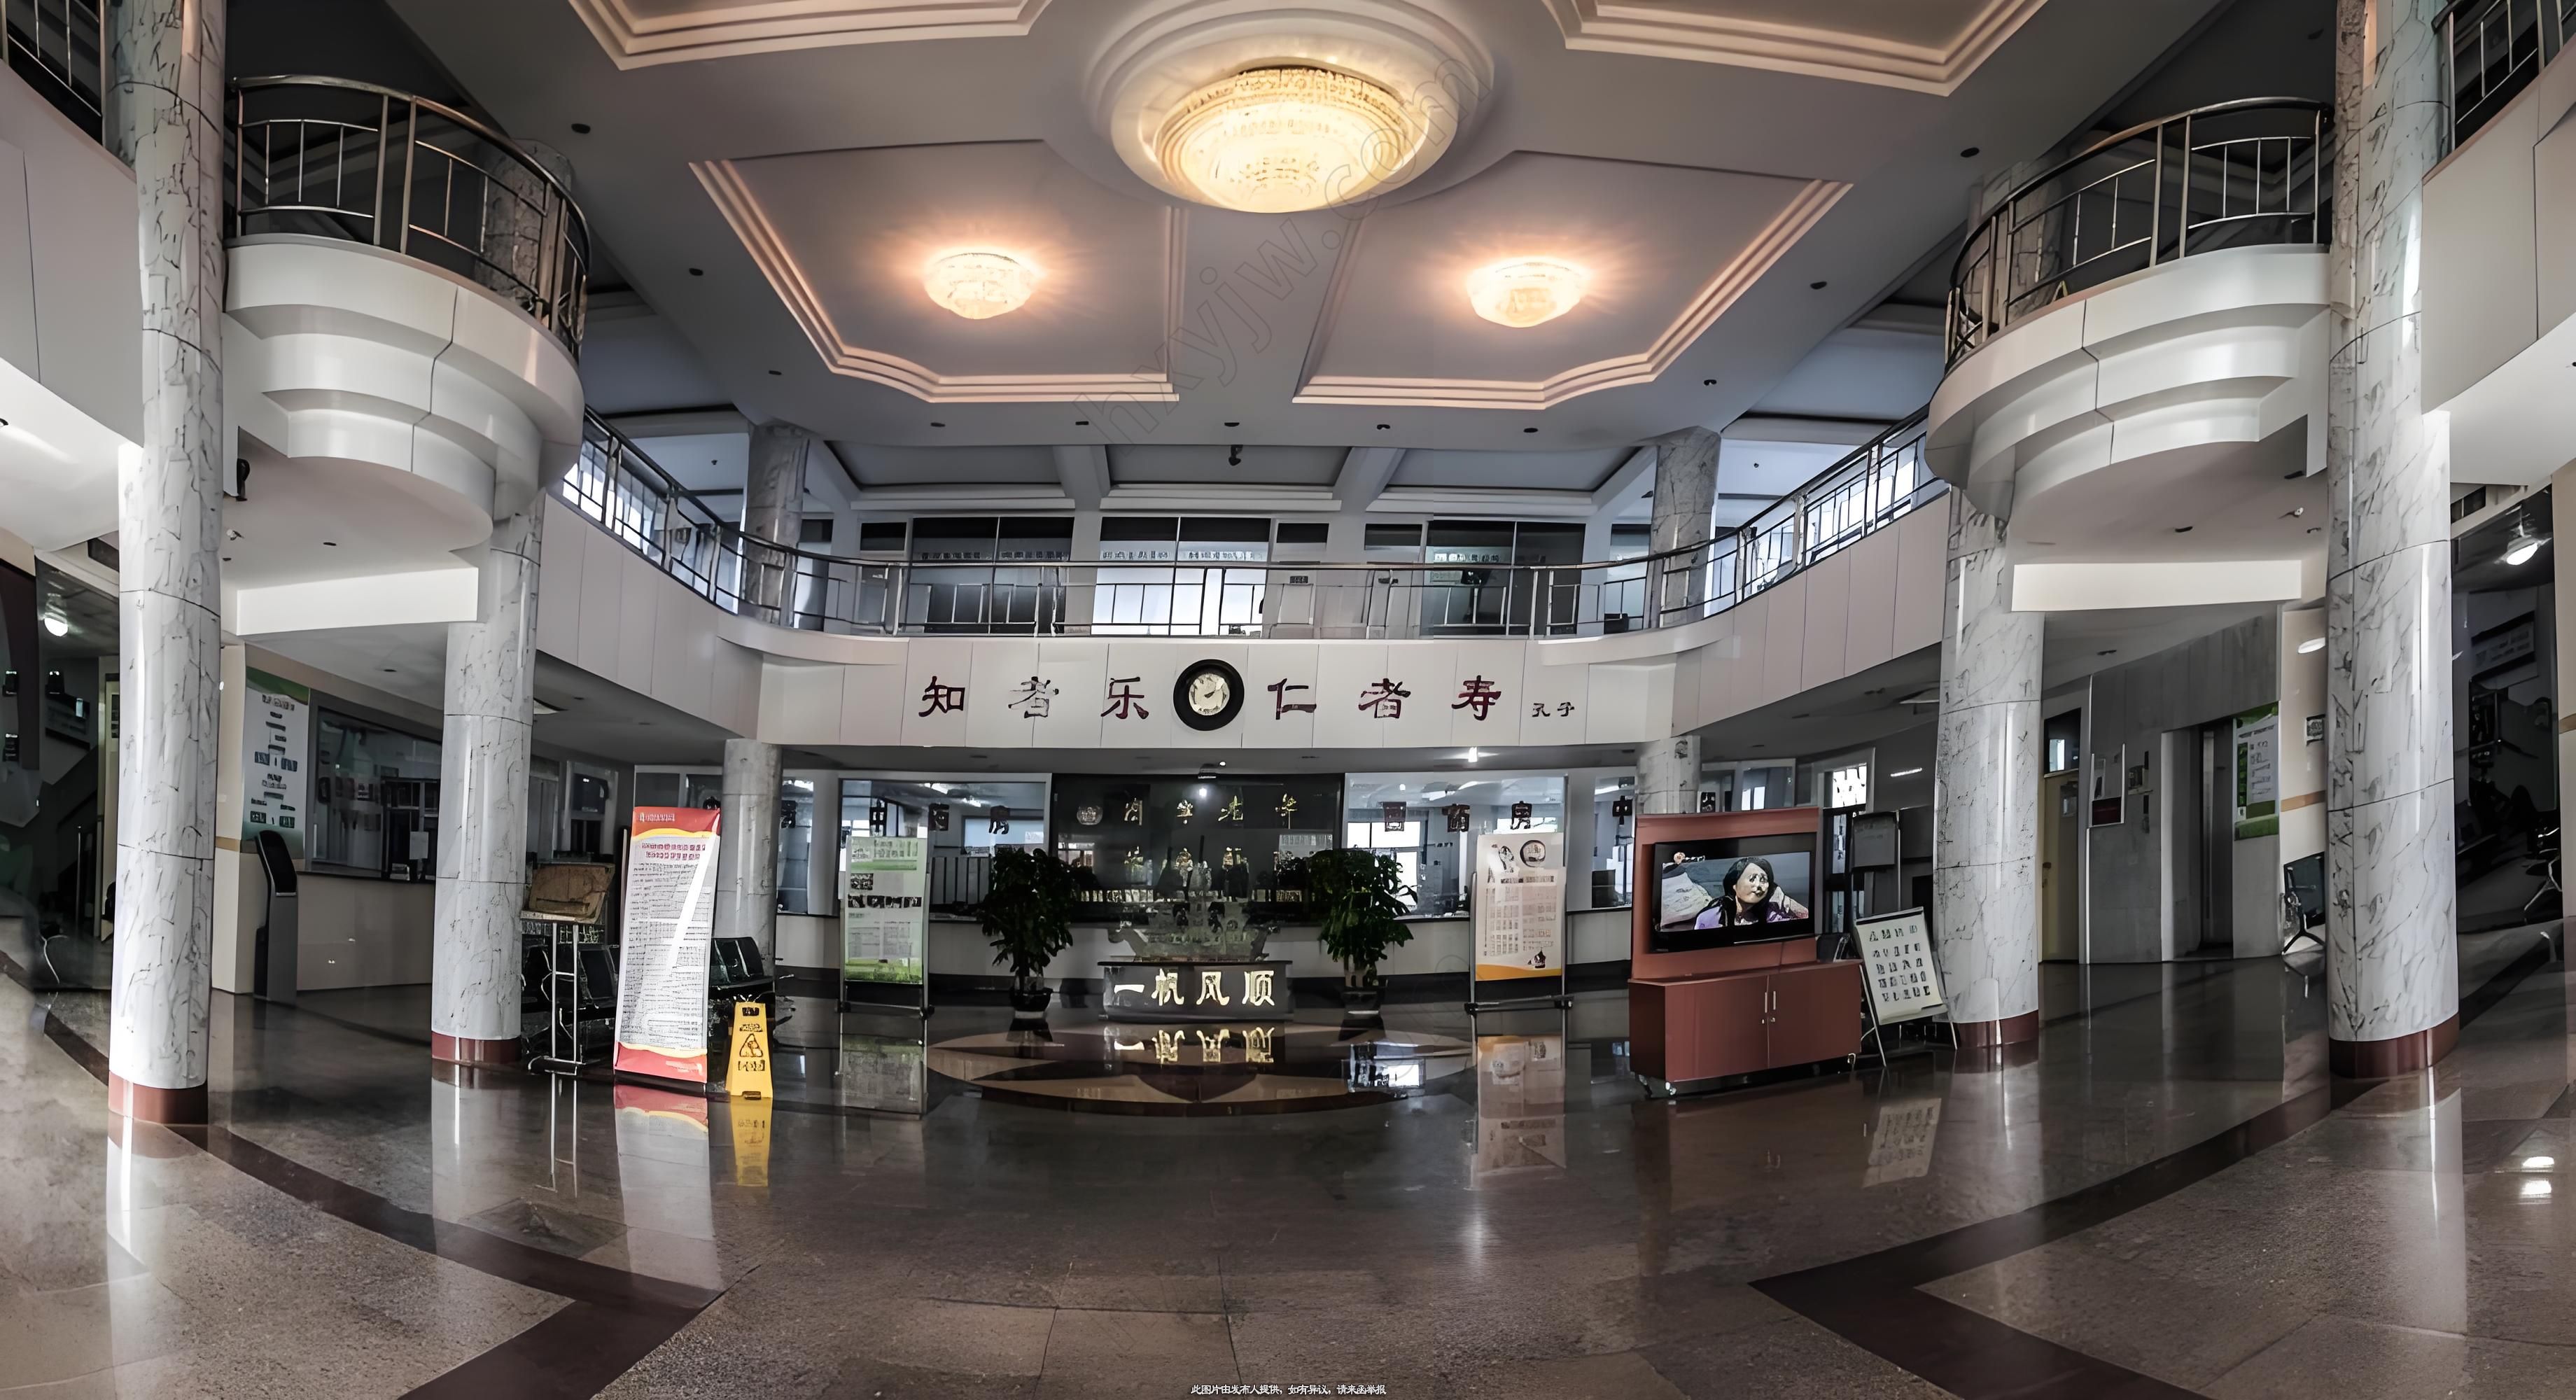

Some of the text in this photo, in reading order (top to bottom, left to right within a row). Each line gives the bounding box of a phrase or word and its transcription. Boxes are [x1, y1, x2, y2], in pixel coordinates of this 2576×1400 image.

[918, 676, 1149, 720] 知者乐
[1268, 674, 1502, 721] 仁者寿
[1114, 968, 1275, 1007] 一帆风顺
